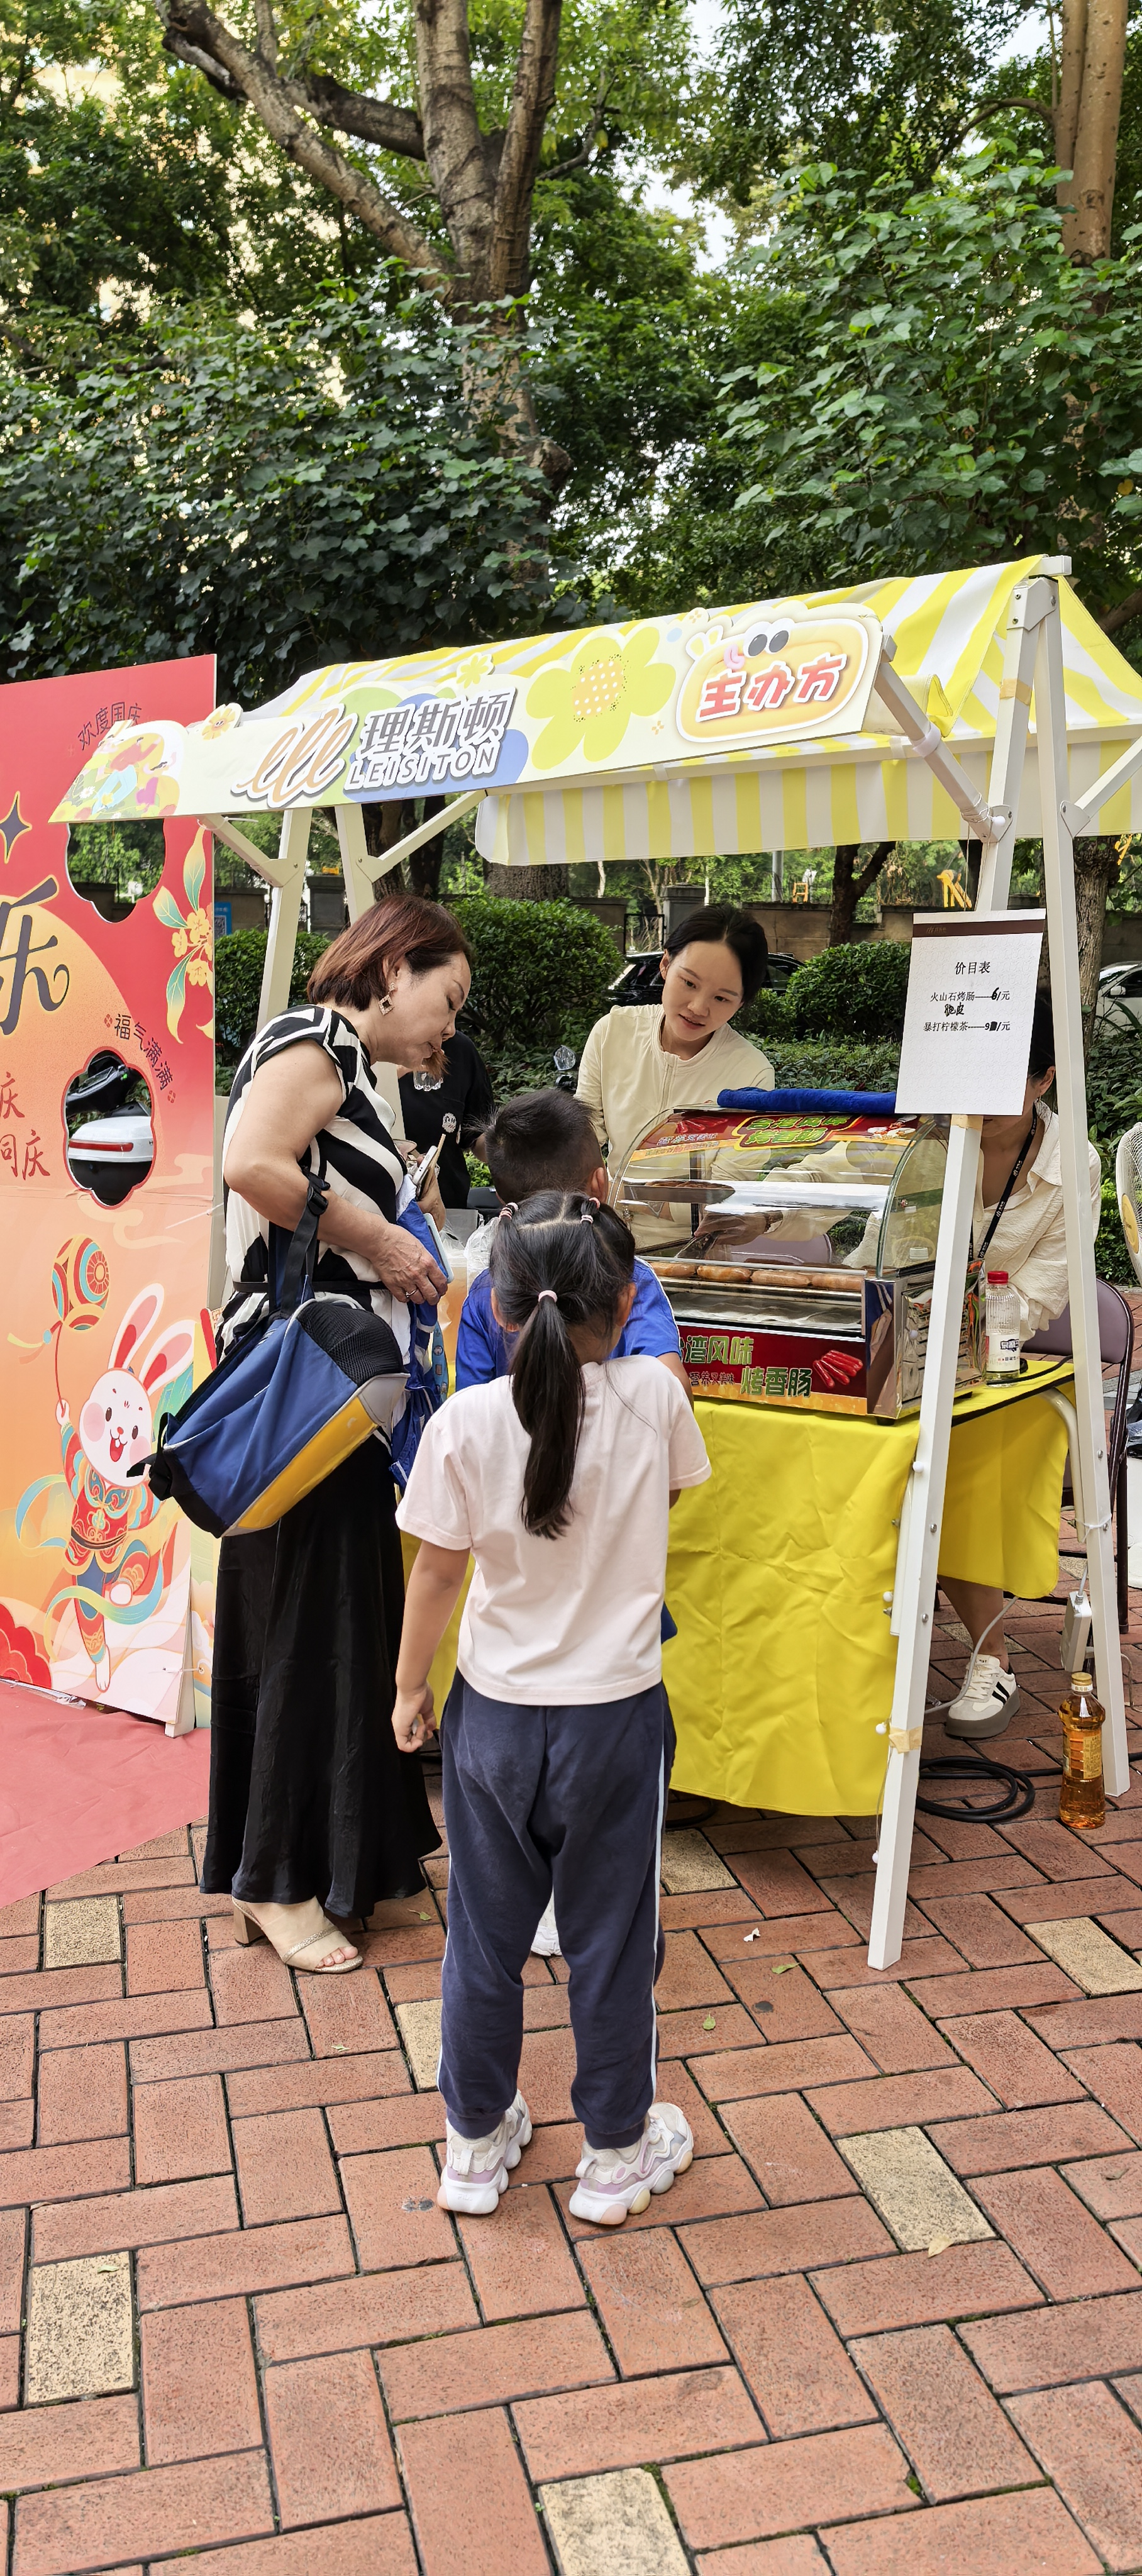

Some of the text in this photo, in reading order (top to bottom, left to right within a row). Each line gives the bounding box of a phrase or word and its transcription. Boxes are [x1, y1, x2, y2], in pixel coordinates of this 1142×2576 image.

[698, 655, 845, 719] 主办方
[77, 701, 142, 751] 欢度国庆
[360, 691, 511, 754] 理斯顿
[350, 746, 497, 785] LEISITON
[955, 961, 990, 975] 价目表
[114, 1014, 173, 1091] 福气满满
[0, 1129, 50, 1180] 同庆
[680, 1335, 754, 1365] 湾风味
[689, 1371, 735, 1386] 营养又美味
[740, 1366, 812, 1397] 烤香肠
